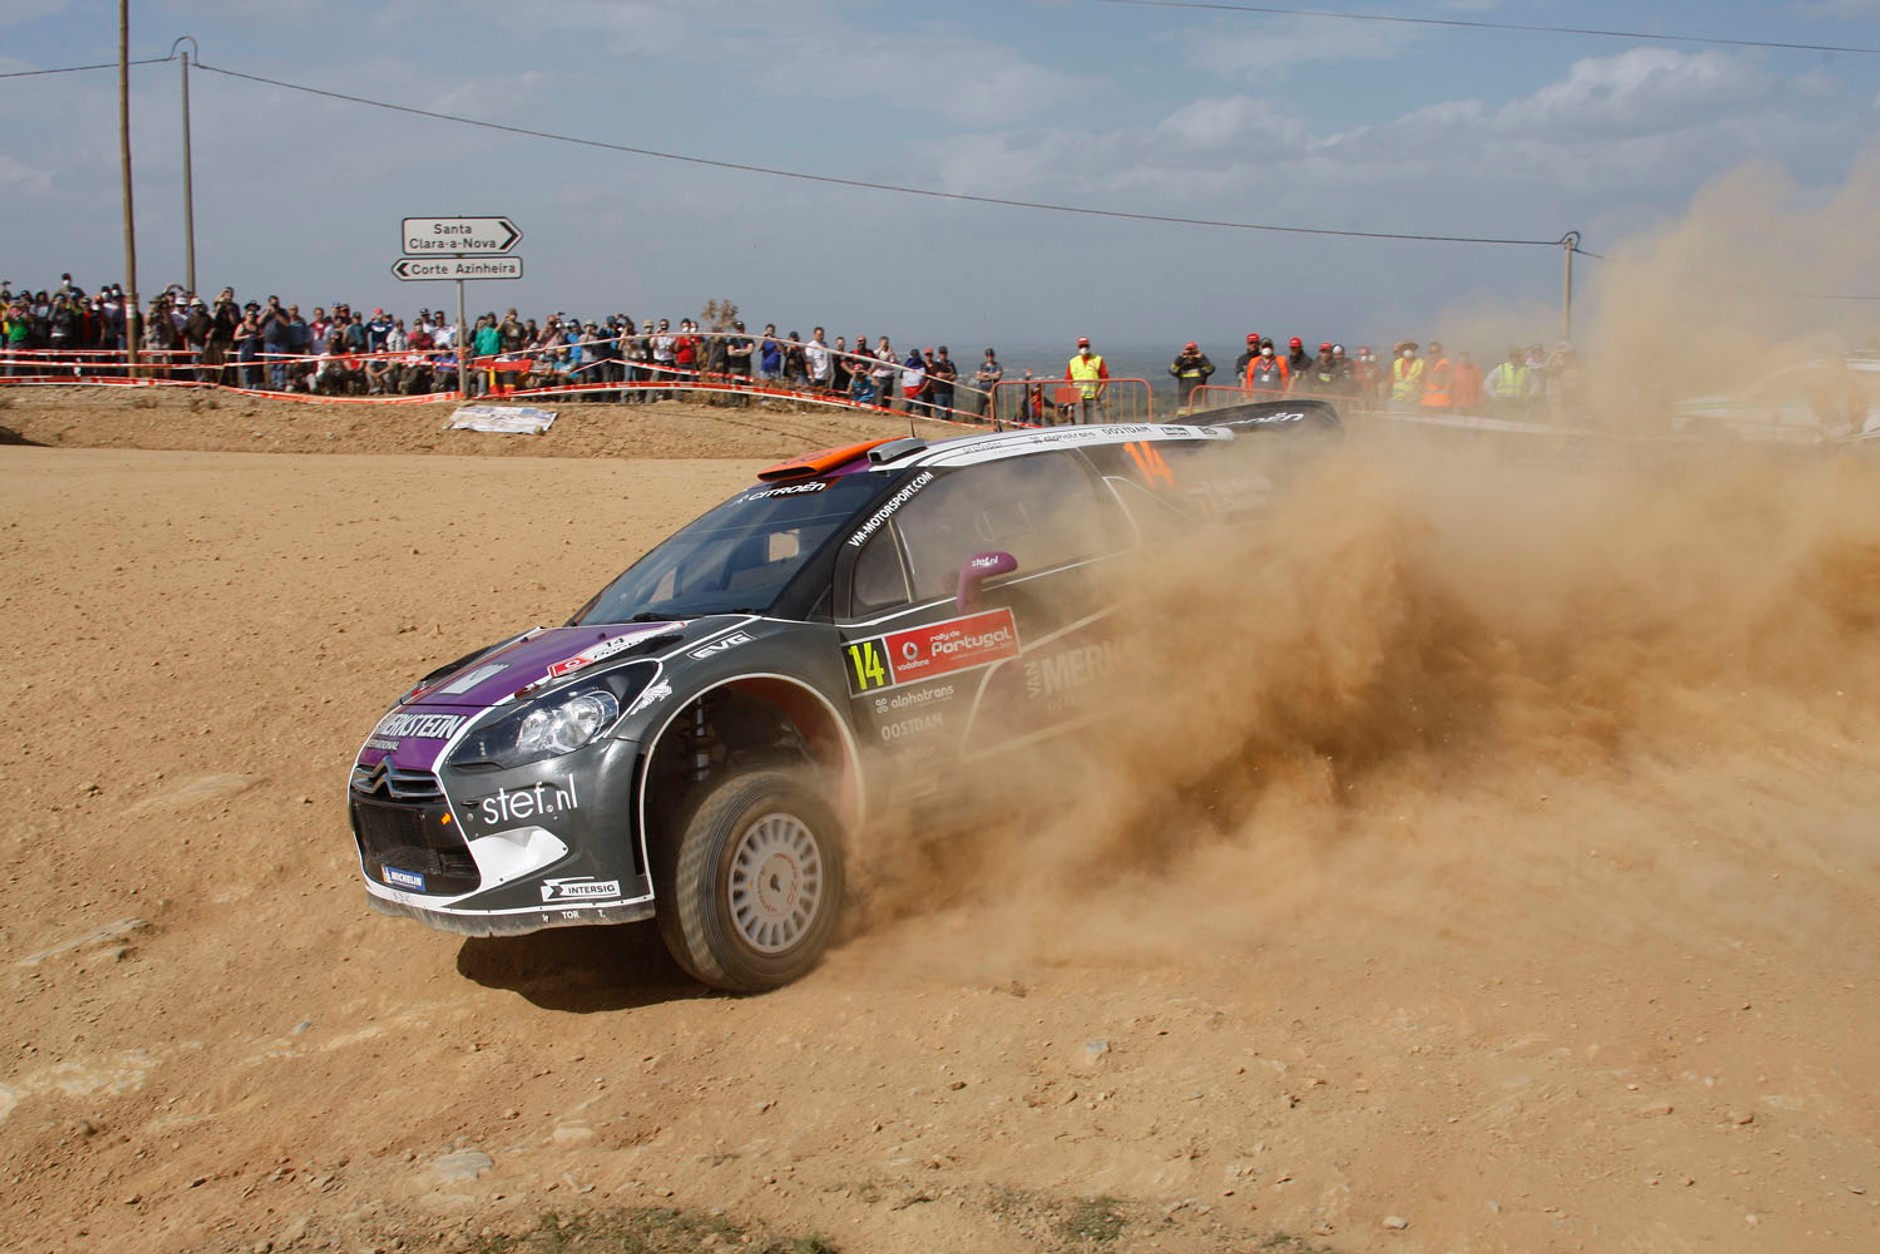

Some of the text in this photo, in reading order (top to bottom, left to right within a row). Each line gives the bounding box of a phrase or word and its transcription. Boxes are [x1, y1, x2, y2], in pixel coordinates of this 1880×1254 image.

[433, 223, 473, 235] Santa
[409, 238, 497, 250] Clara-a-Nova
[411, 263, 517, 275] Corte Azinheira
[1123, 440, 1176, 491] 14
[848, 471, 934, 547] VM-MOTORSPORT.COM
[971, 555, 999, 567] stef.nl
[693, 634, 752, 659] EVG
[931, 626, 1013, 657] Portugal
[848, 642, 885, 690] 14
[897, 659, 930, 672] vodafone
[891, 685, 955, 709] alphatrans
[881, 711, 944, 741] OOSTDAM
[482, 773, 578, 825] stef.nl
[567, 884, 616, 895] INTERSIG
